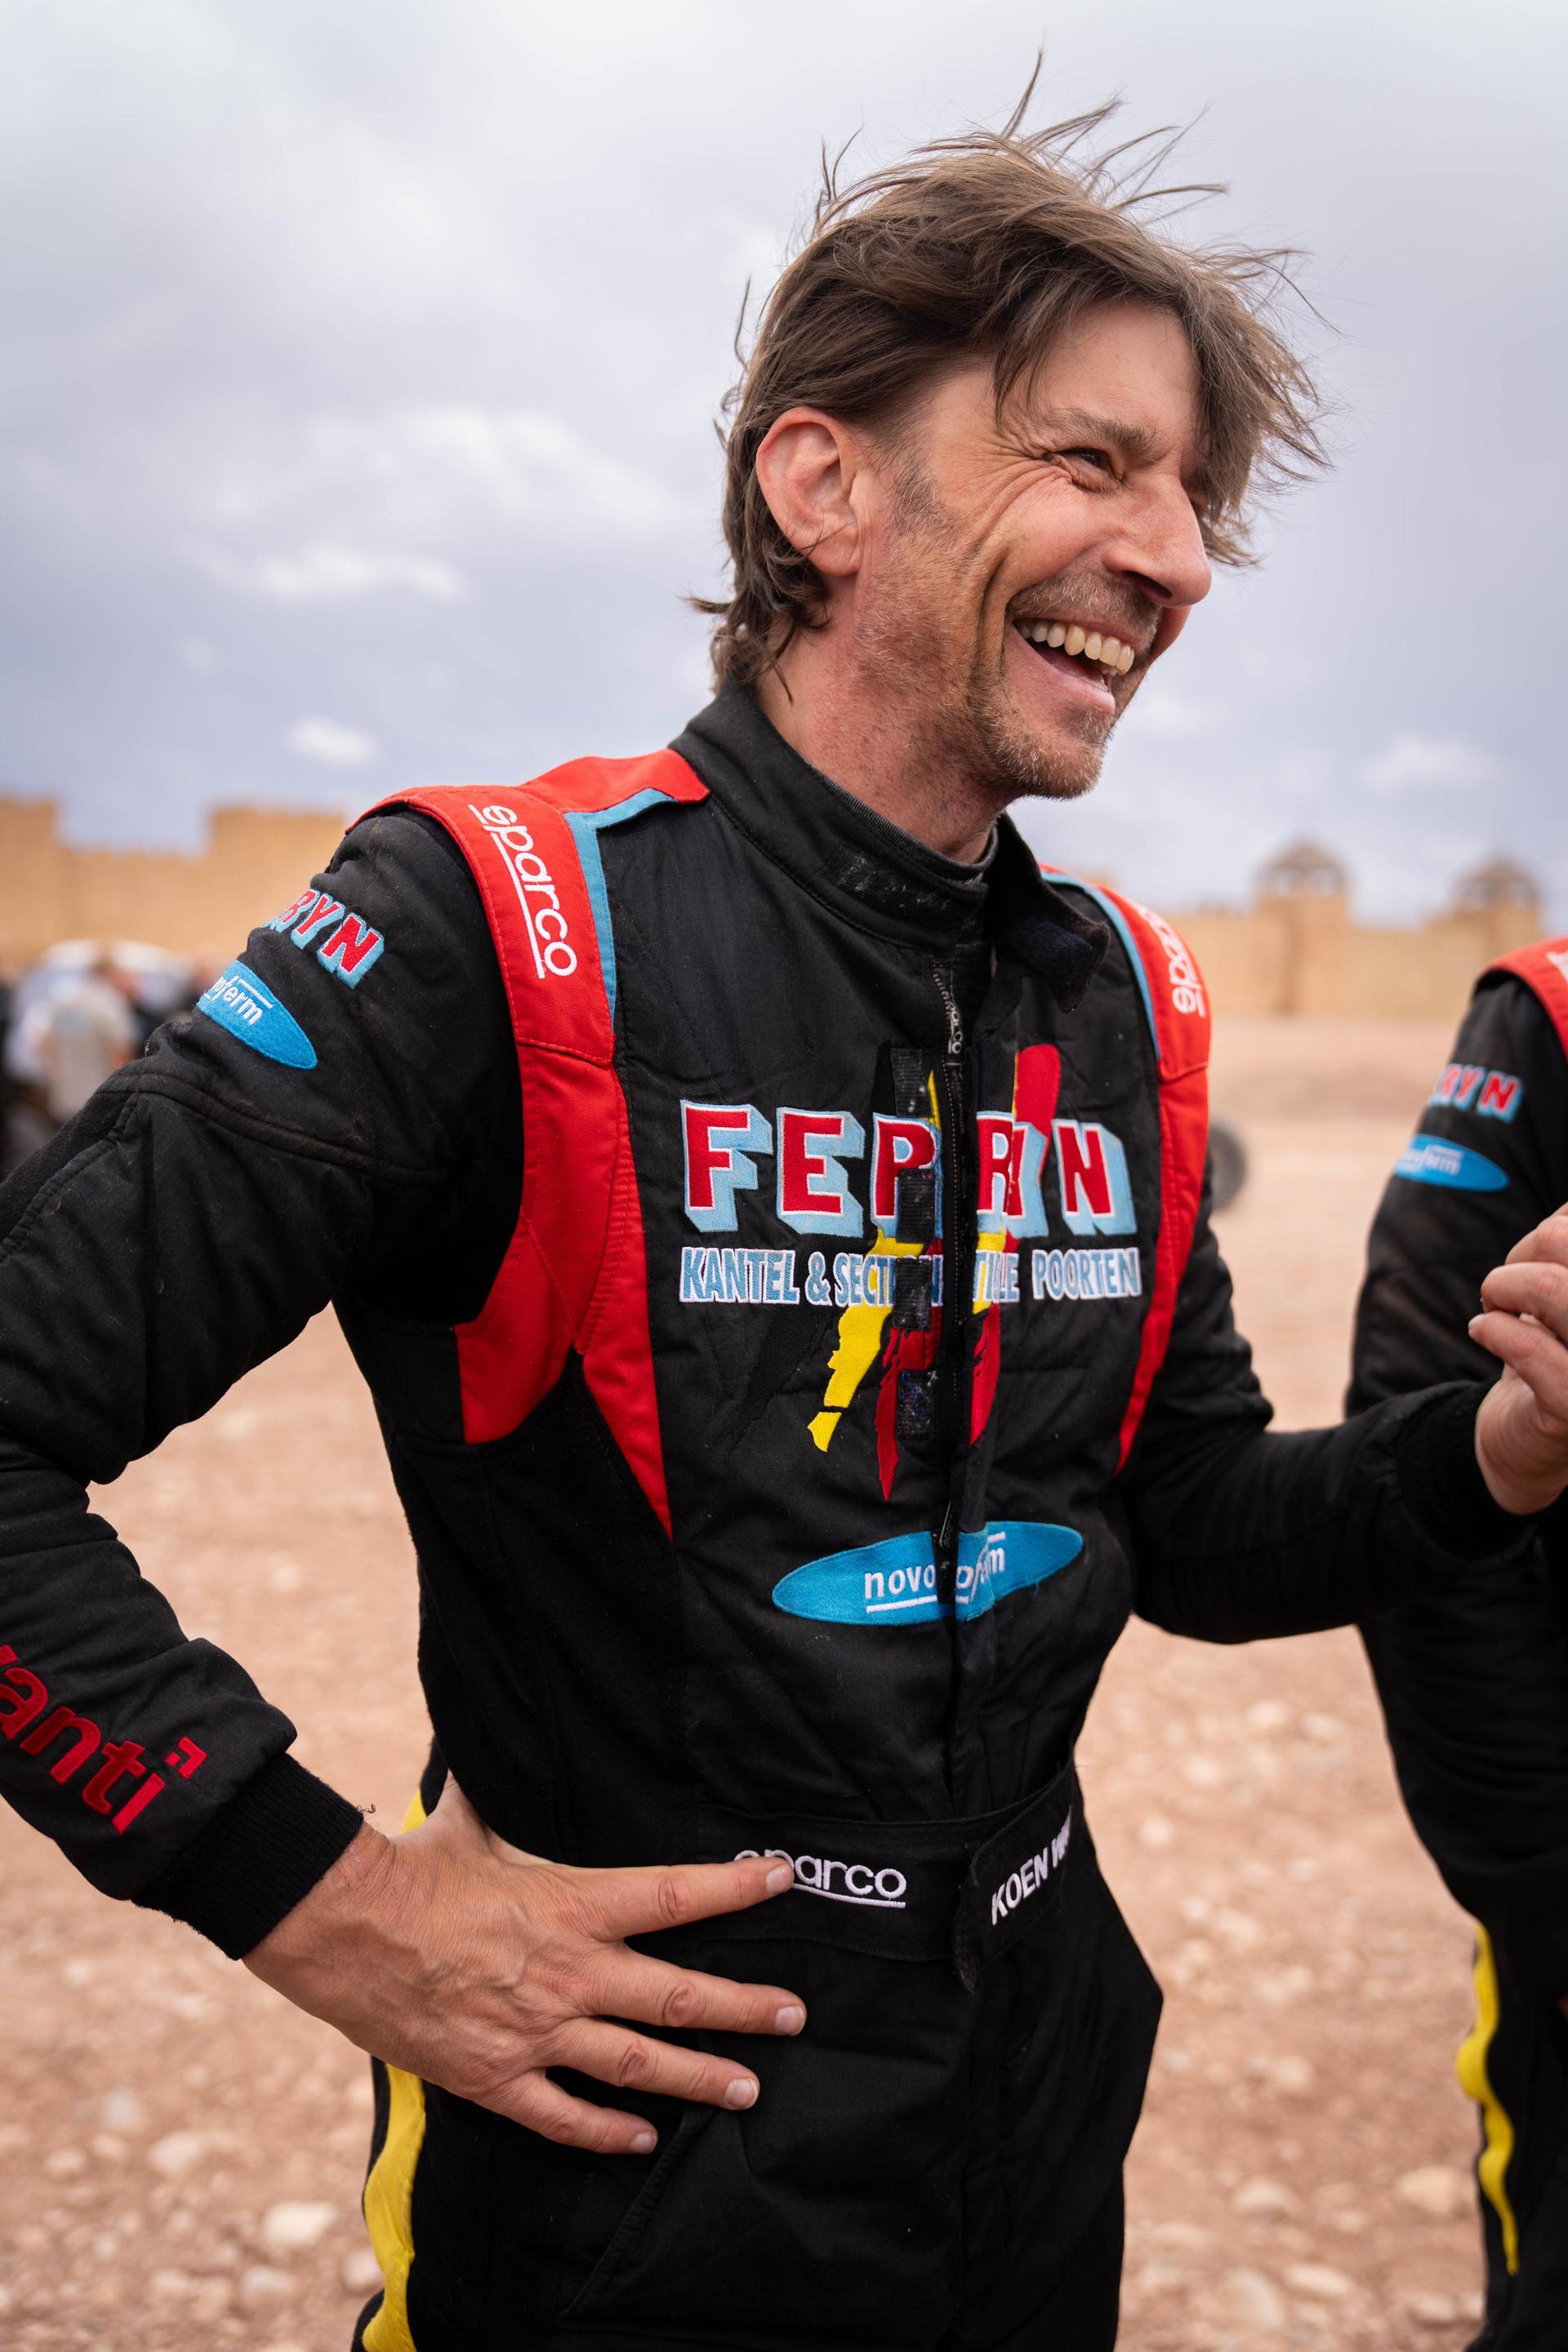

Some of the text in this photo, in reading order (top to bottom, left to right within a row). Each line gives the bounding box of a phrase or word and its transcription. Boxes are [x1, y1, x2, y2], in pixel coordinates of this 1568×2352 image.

[468, 804, 577, 979] sparco
[261, 888, 385, 990] RYN
[679, 1247, 800, 1304] KANTEL
[804, 1251, 832, 1307] &
[1032, 1248, 1141, 1301] POORTEN
[0, 1645, 181, 1835] anti
[733, 1849, 907, 1908] arco
[991, 1846, 1049, 1926] KOEN
